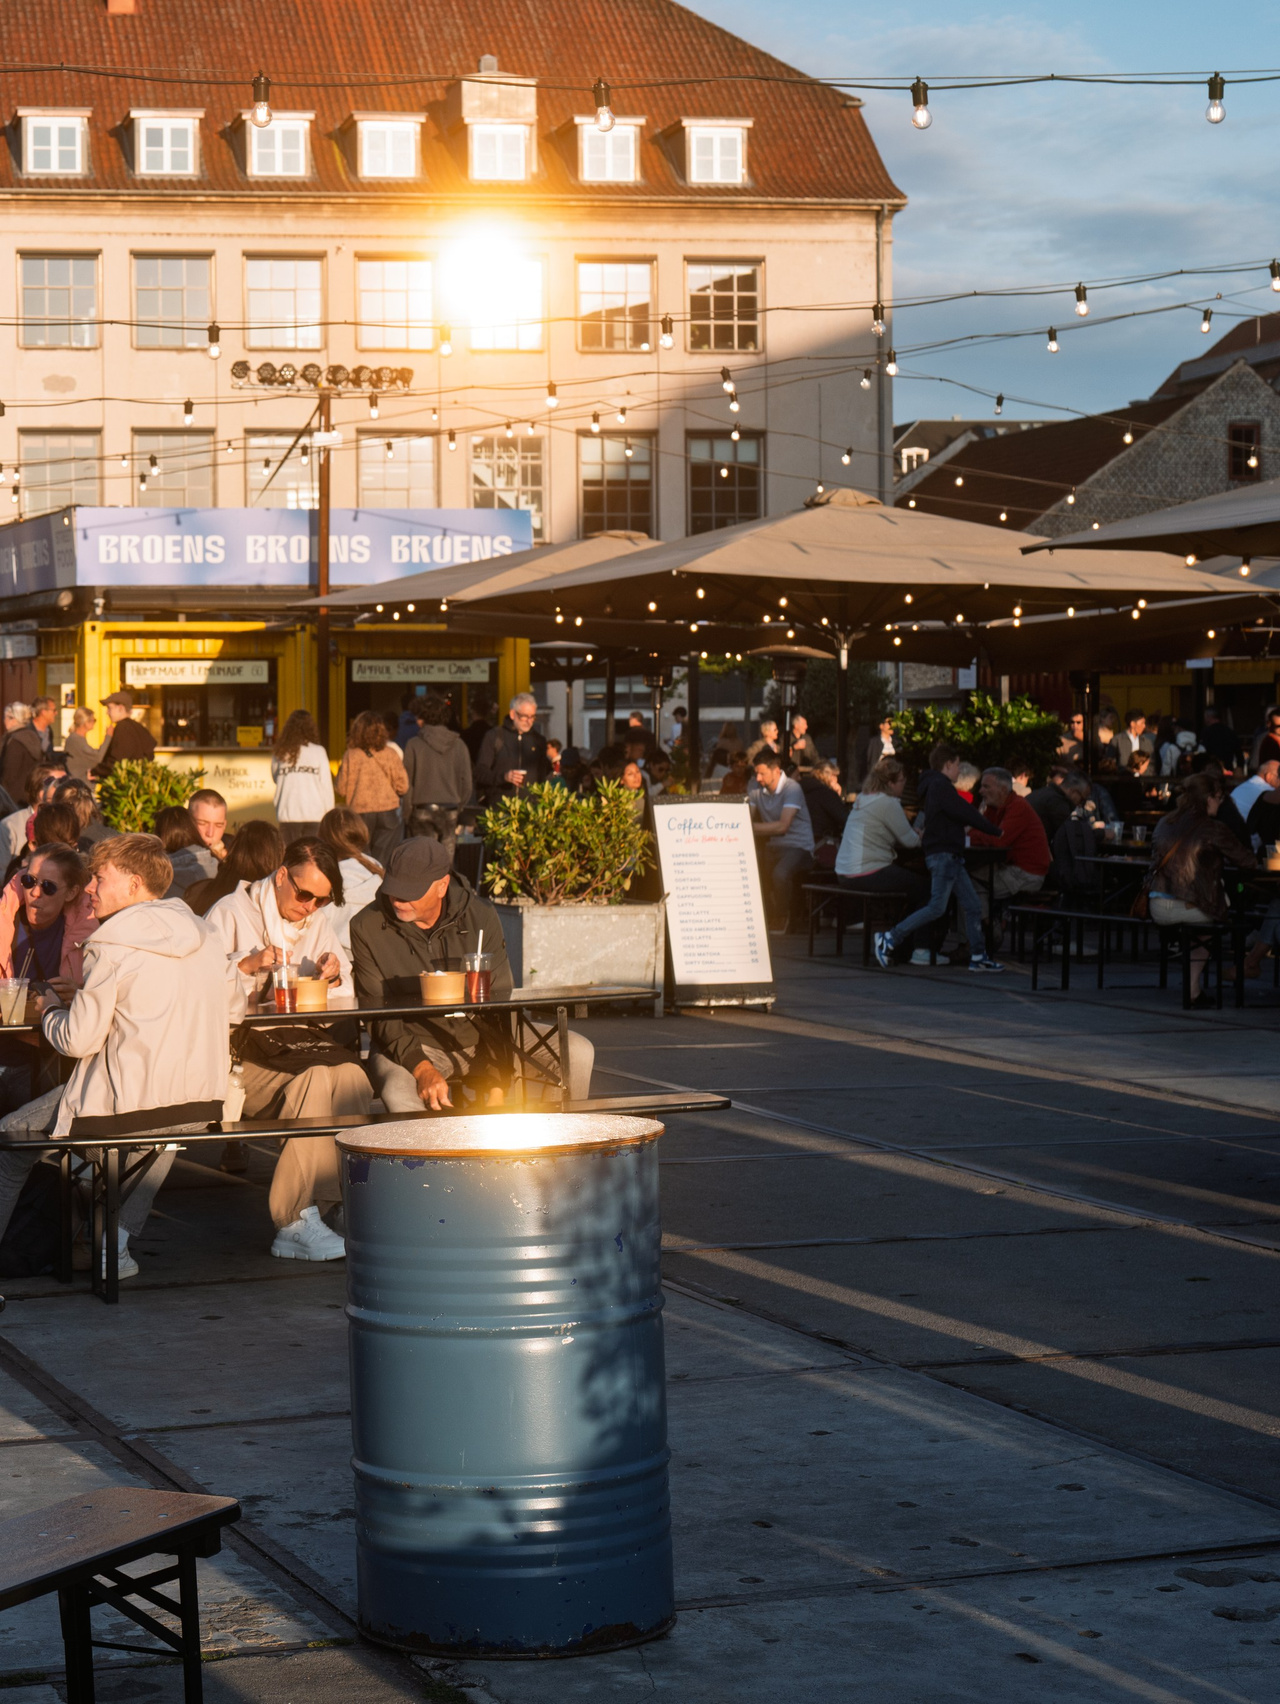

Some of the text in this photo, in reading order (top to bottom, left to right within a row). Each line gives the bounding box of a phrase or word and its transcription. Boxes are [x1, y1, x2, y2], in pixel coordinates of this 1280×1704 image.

[98, 534, 226, 564] BROENS
[391, 534, 512, 564] BROENS
[667, 815, 741, 835] Coffee Corner
